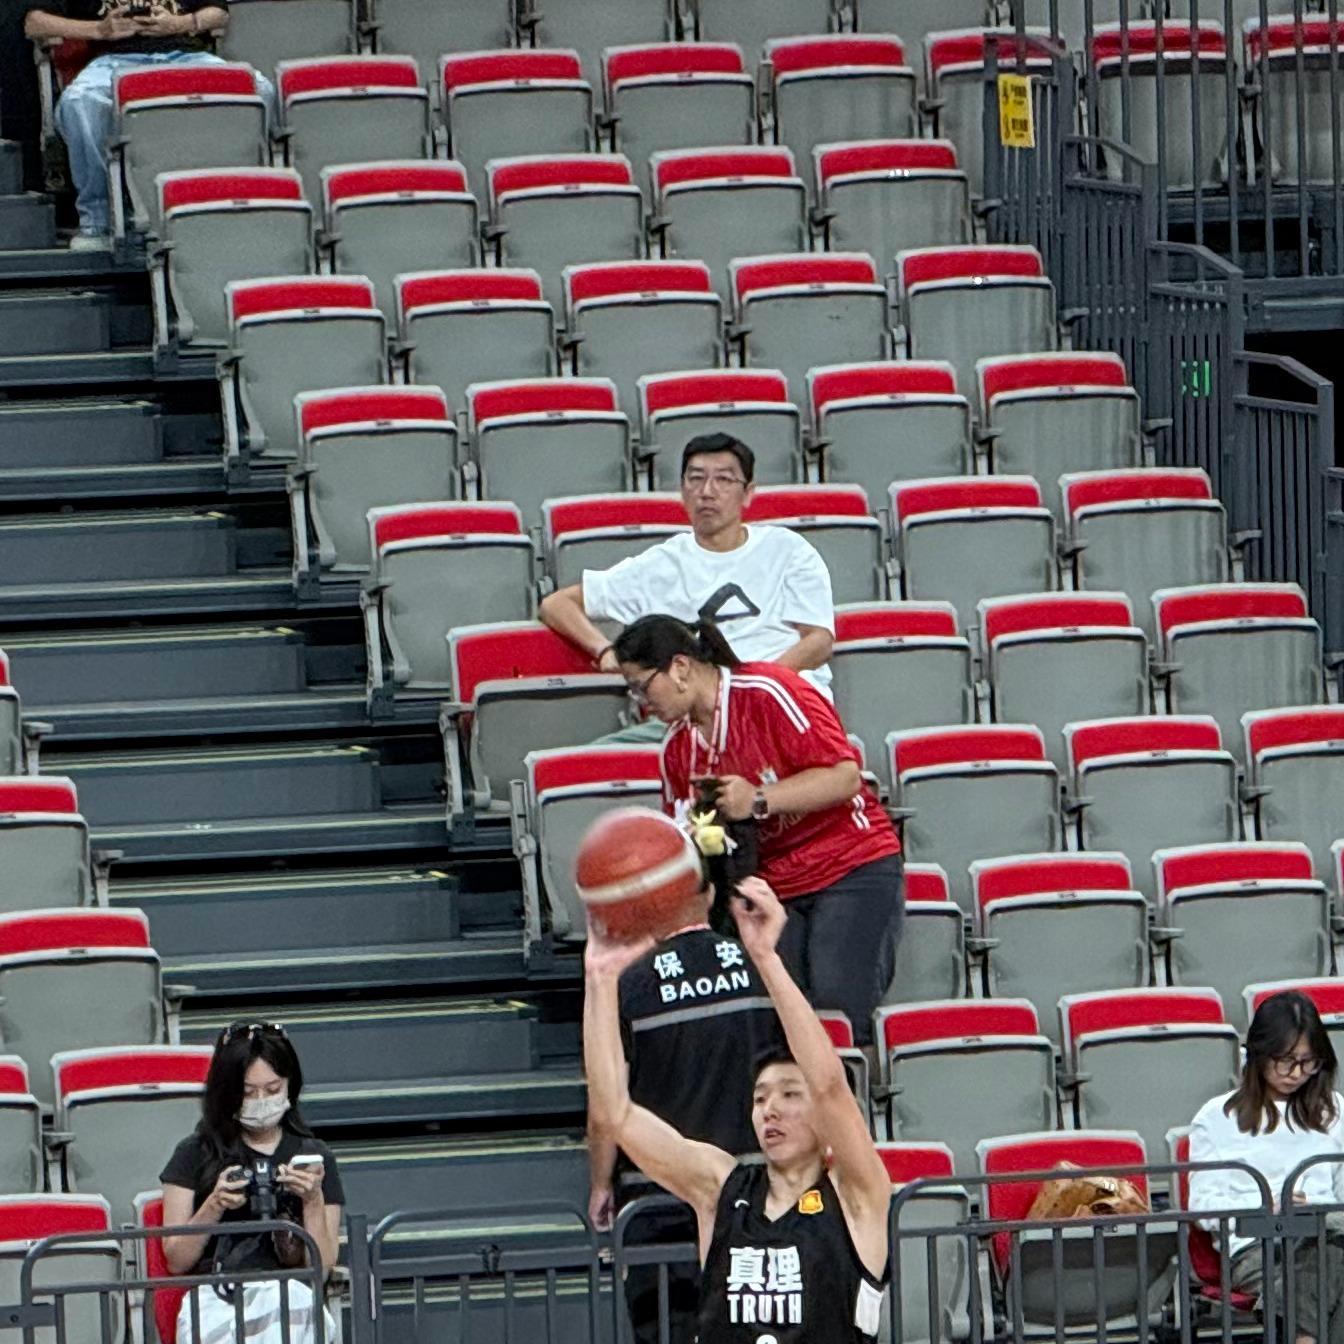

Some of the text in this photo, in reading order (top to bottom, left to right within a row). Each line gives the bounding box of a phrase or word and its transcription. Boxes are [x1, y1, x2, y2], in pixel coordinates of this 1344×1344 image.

[654, 941, 743, 979] 保安
[659, 970, 750, 1003] BAOAN
[726, 1246, 803, 1293] 真理
[727, 1294, 802, 1324] TRUTH
